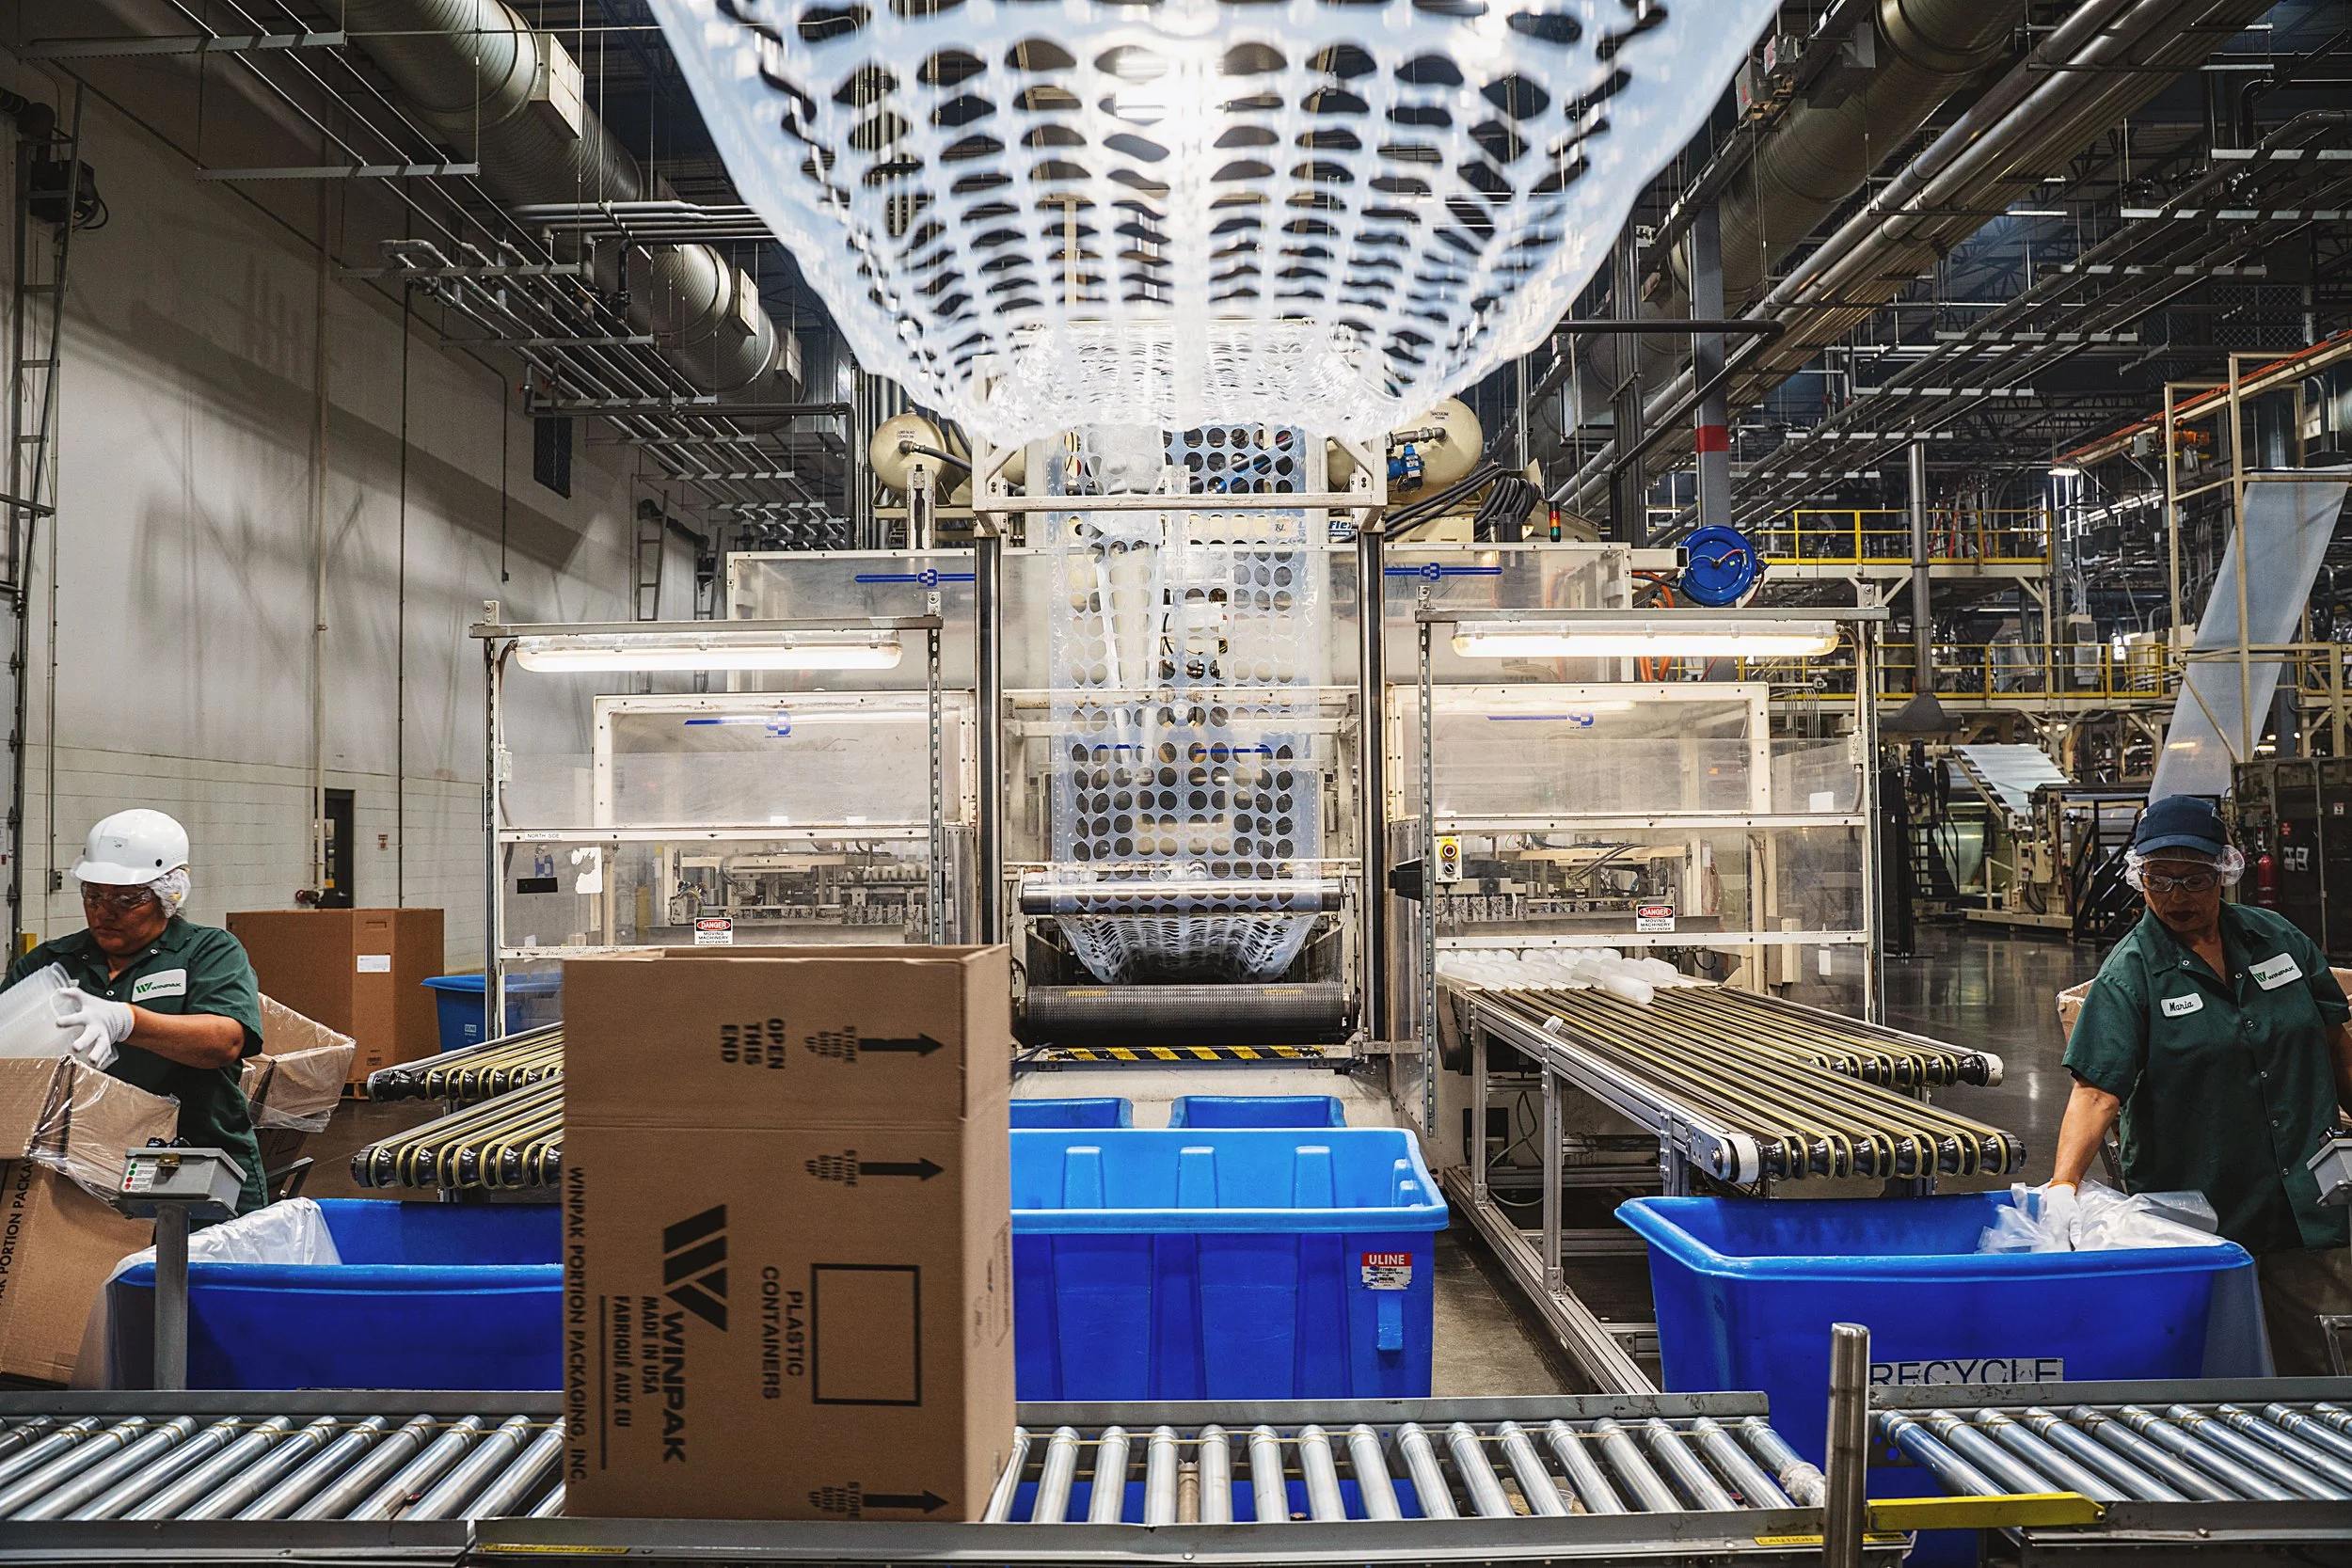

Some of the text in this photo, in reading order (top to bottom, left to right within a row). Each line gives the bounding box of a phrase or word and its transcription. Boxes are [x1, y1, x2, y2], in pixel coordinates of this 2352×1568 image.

[701, 921, 726, 929] DANGER
[1643, 908, 1669, 916] DANGER
[151, 982, 182, 990] WINPAK
[2267, 965, 2296, 980] WINPAK
[2169, 1001, 2195, 1012] Maria
[721, 1024, 739, 1063] END
[744, 1022, 763, 1065] THIS
[767, 1018, 786, 1069] OPEN
[0, 1213, 23, 1275] PORTION
[1369, 1254, 1405, 1265] ULINE
[568, 1166, 587, 1484] WINPAK PORTION PACKAGING, INC.
[642, 1296, 659, 1395] MADE IN USA
[761, 1266, 780, 1400] CONTAINERS
[786, 1291, 804, 1377] PLASTIC
[613, 1295, 635, 1428] FABRIQUÉ AUX EU
[662, 1310, 686, 1464] WINPAK
